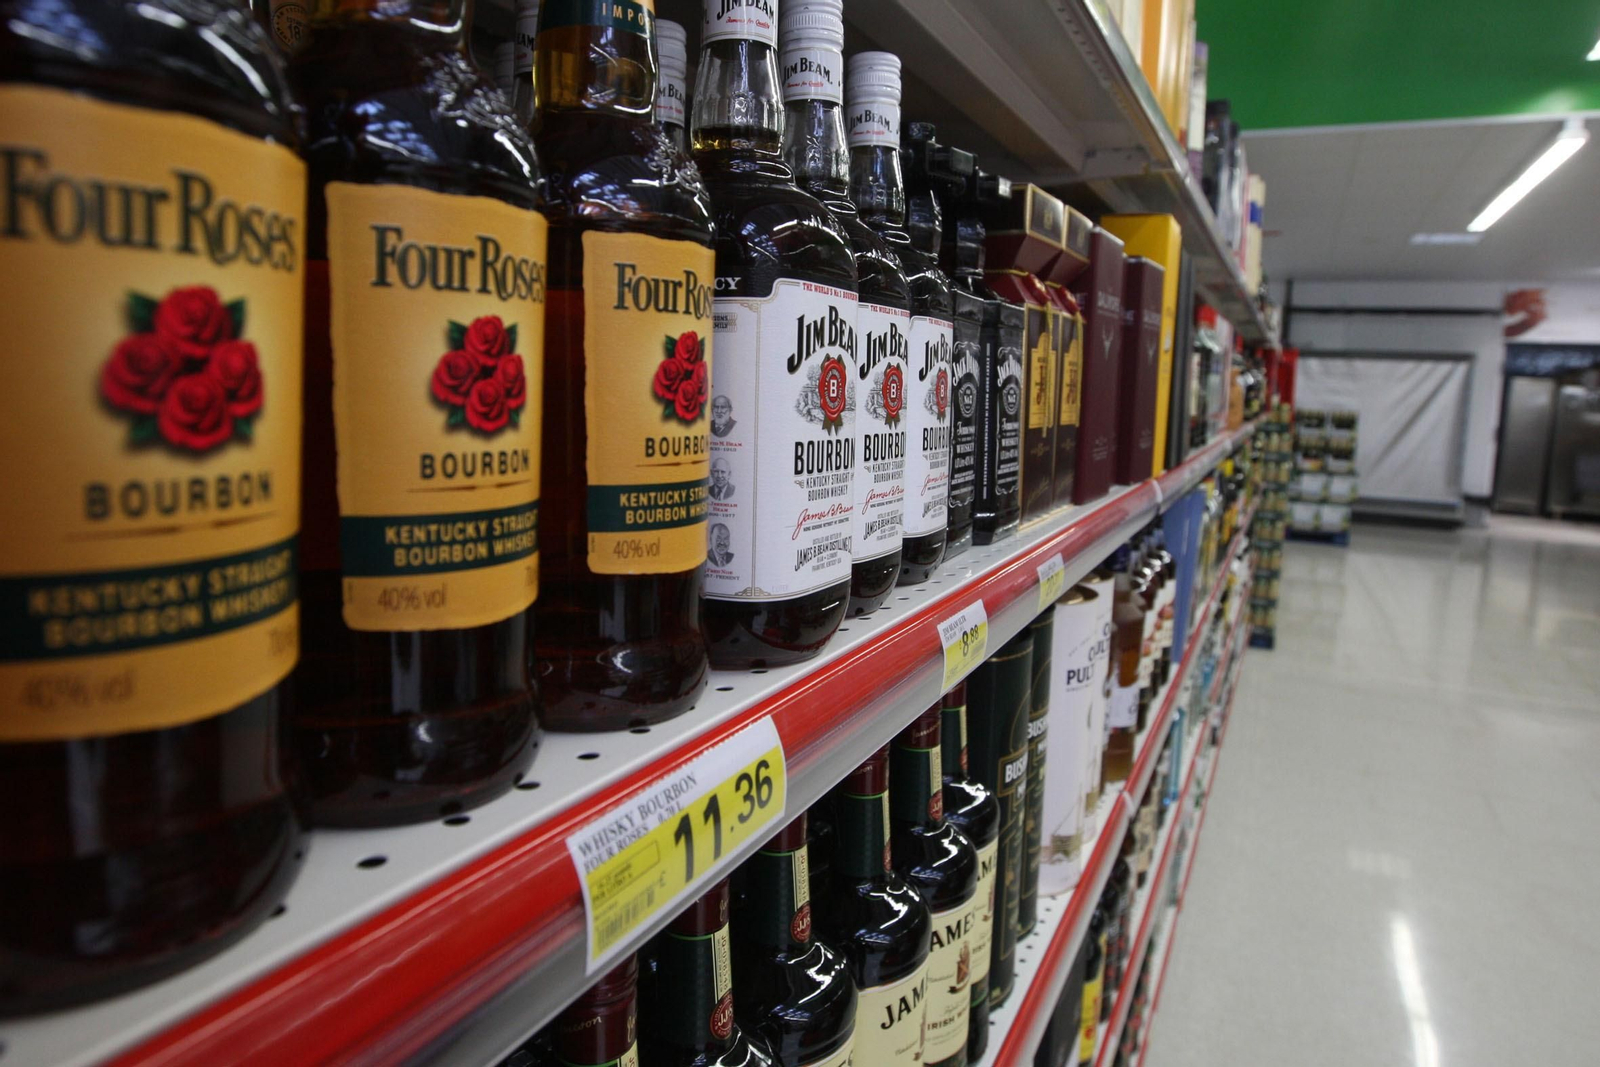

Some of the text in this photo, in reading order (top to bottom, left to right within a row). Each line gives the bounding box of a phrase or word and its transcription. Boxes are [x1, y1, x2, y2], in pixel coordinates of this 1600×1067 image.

[602, 3, 648, 26] IMPO
[172, 167, 298, 273] Roses
[370, 223, 475, 293] Four
[613, 261, 714, 321] Four Ros
[787, 314, 826, 375] JIM
[859, 331, 888, 381] JIM
[919, 340, 939, 382] JIM
[830, 379, 838, 397] B
[794, 438, 856, 476] BOURBON
[864, 430, 906, 462] BOURBO
[420, 449, 530, 480] BOURBON
[84, 471, 271, 522] BOURBON
[620, 488, 687, 508] KENTUCKY
[385, 520, 488, 545] KENTUCKY
[626, 506, 687, 525] BOURBON
[394, 542, 488, 568] BOURBON
[613, 539, 643, 560] 40%
[644, 537, 661, 557] vol
[578, 770, 698, 858] WHISKY BOURBON
[674, 758, 774, 884] 11.36
[927, 1016, 956, 1032] IRISH
